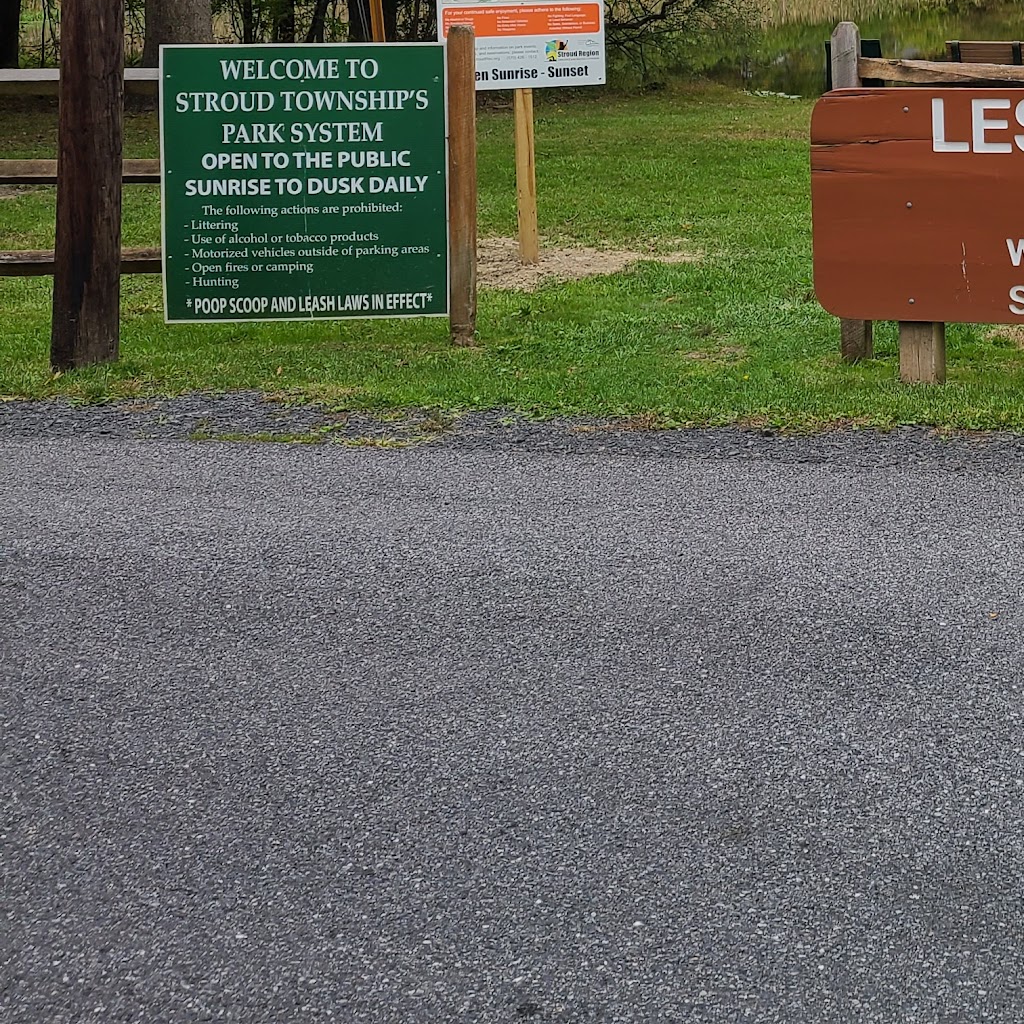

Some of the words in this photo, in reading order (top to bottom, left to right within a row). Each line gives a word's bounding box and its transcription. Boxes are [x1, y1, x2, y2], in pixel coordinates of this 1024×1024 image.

[220, 59, 339, 80] WELCOME
[345, 58, 379, 79] TO
[492, 68, 538, 80] Sunrise
[548, 65, 588, 77] Sunset
[175, 91, 274, 112] STROUD
[280, 90, 428, 111] TOWNSHIP'S
[222, 123, 285, 144] PARK
[291, 122, 383, 143] SYSTEM
[201, 153, 258, 170] OPEN
[261, 153, 289, 168] TO
[293, 152, 333, 168] THE
[338, 151, 411, 168] PUBLIC
[185, 179, 271, 196] SUNRISE
[275, 178, 302, 195] TO
[308, 177, 365, 194] DUSK
[369, 176, 428, 192] DAILY
[202, 206, 222, 215] The
[226, 204, 278, 217] following
[281, 204, 320, 214] actions
[322, 204, 339, 213] are
[342, 202, 403, 215] prohibited:
[191, 220, 238, 232] Littering
[192, 235, 211, 244] Use
[215, 233, 225, 243] of
[228, 233, 268, 243] alcohol
[286, 233, 327, 243] tobacco
[330, 231, 379, 245] products
[192, 248, 248, 258] Motorized
[251, 247, 295, 257] vehicles
[298, 247, 339, 257] outside
[342, 246, 353, 256] of
[356, 245, 399, 258] parking
[401, 245, 430, 254] areas
[192, 263, 222, 275] Open
[225, 262, 249, 272] fires
[252, 263, 263, 271] or
[266, 262, 314, 273] camping
[193, 277, 239, 289] Hunting
[195, 298, 226, 314] POOP
[229, 298, 268, 314] SCOOP
[271, 297, 296, 313] AND
[298, 296, 335, 312] LEASH
[338, 295, 369, 311] LAWS
[372, 294, 384, 310] IN
